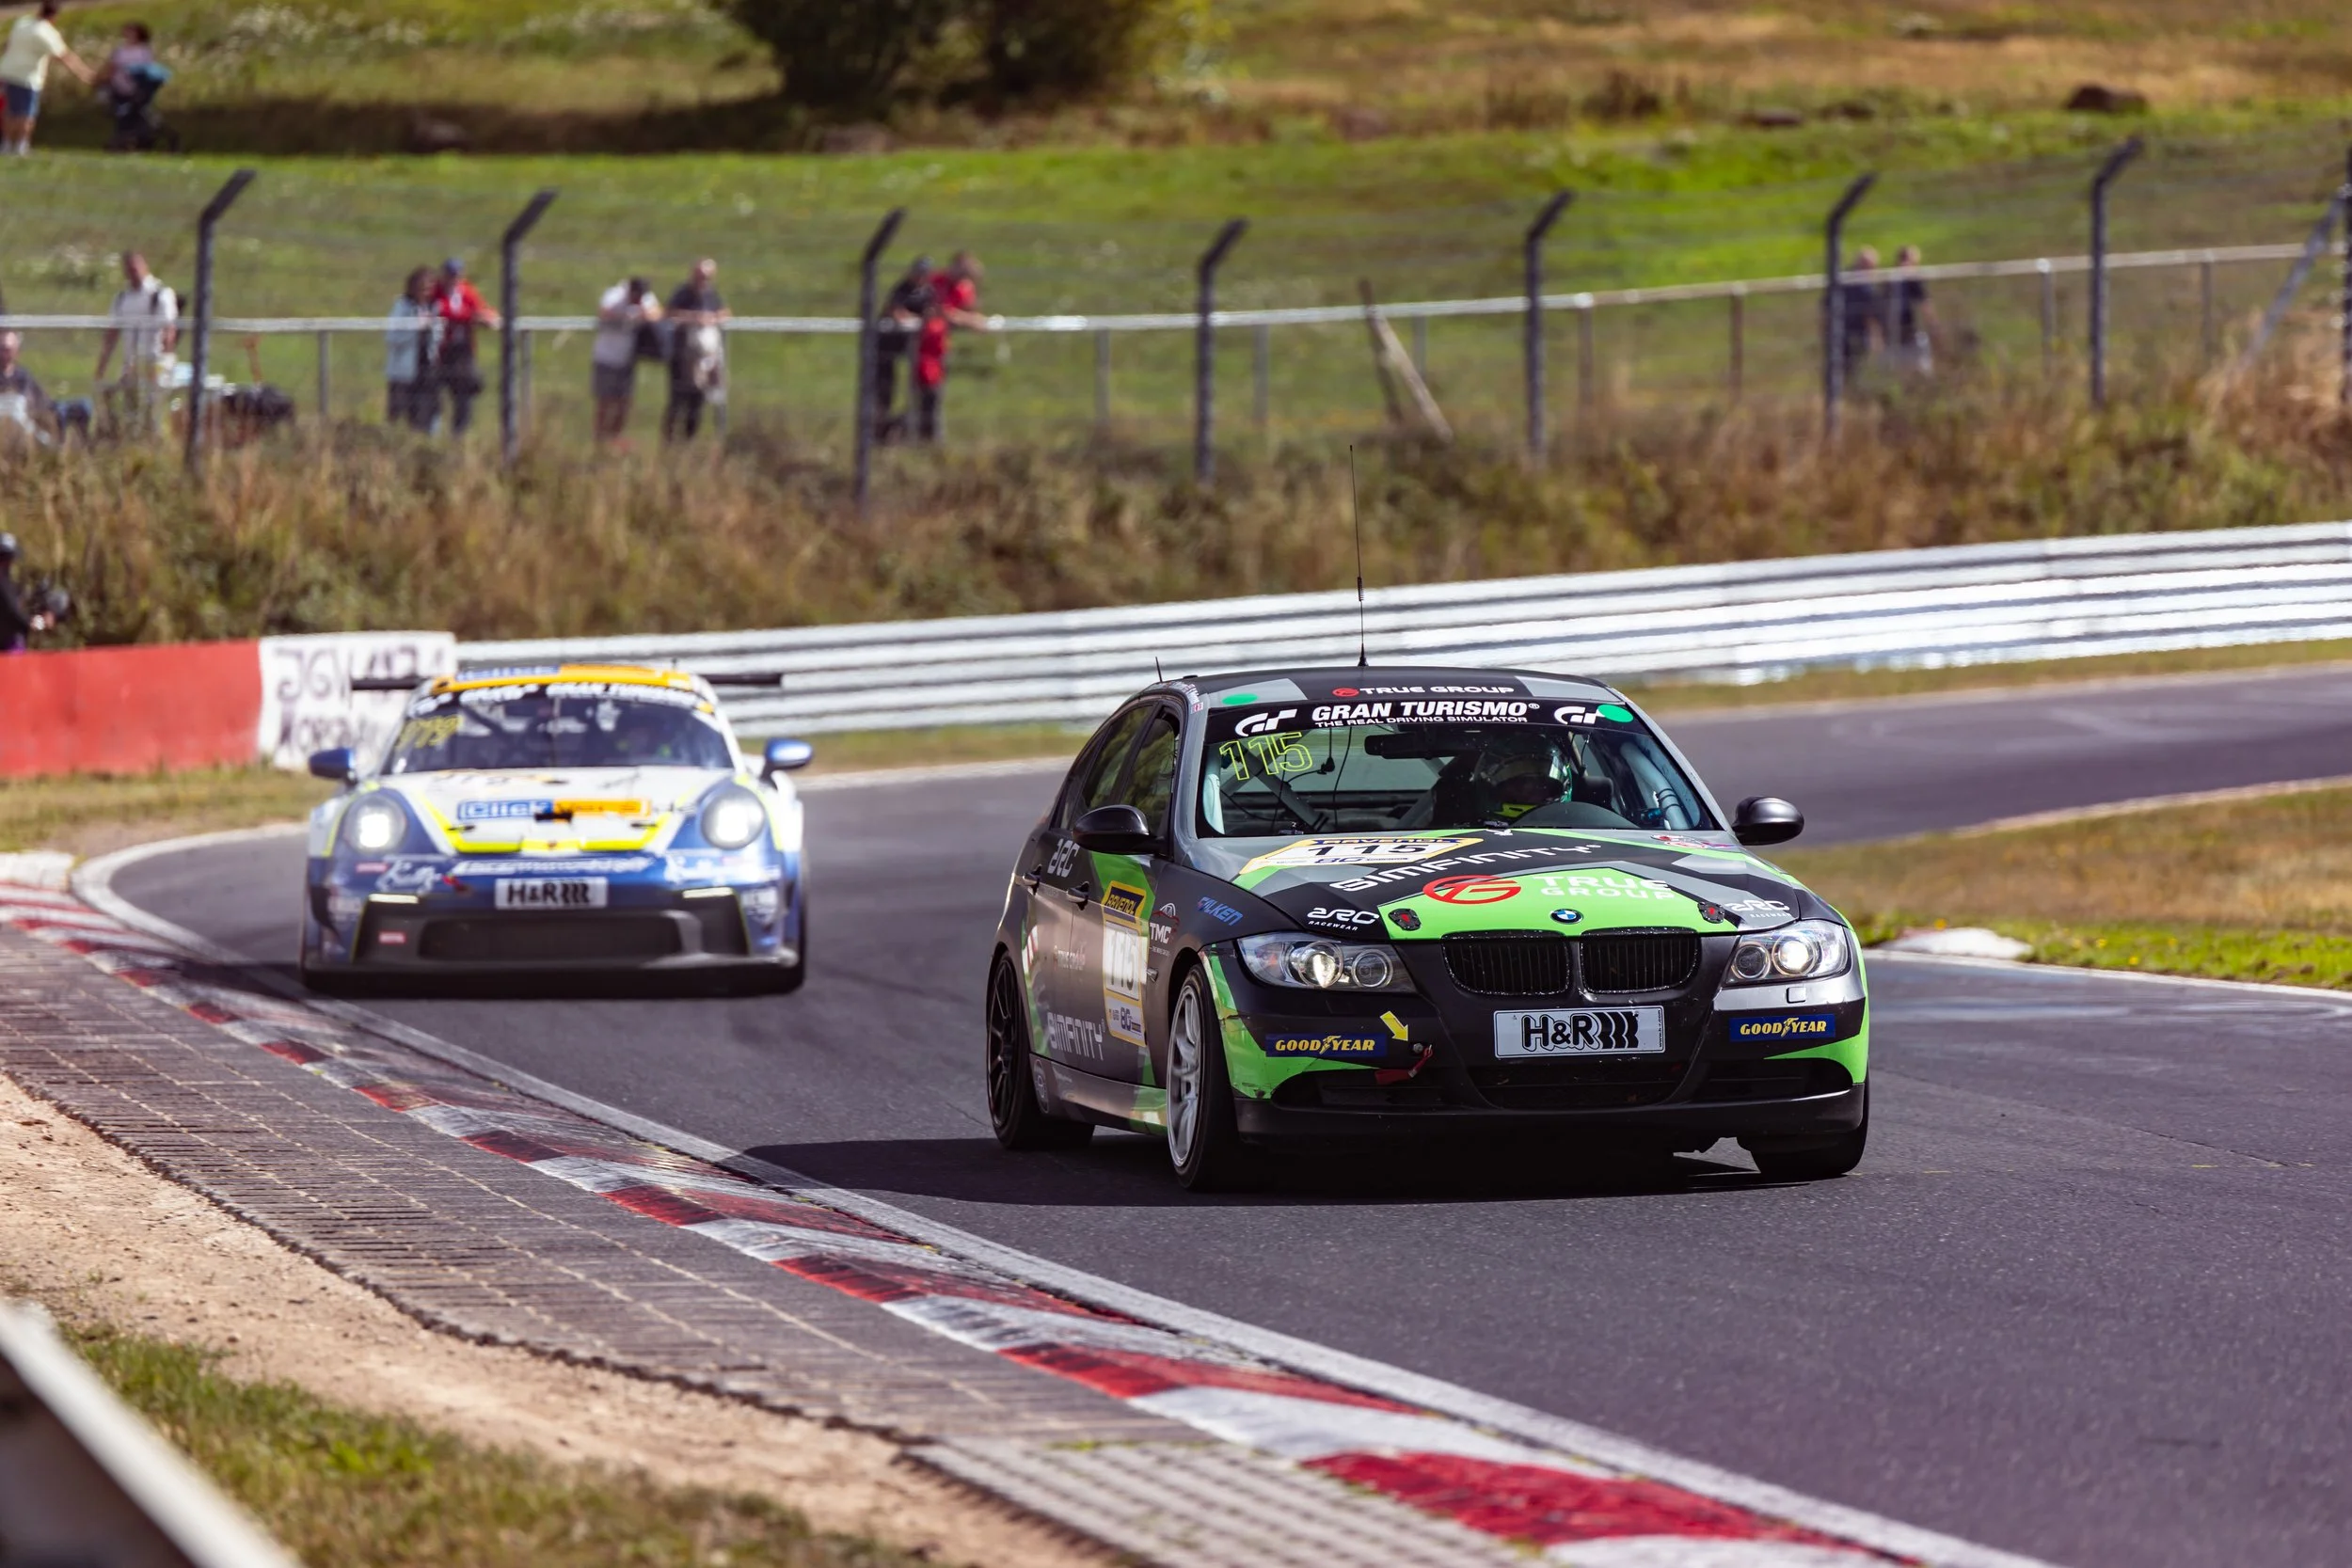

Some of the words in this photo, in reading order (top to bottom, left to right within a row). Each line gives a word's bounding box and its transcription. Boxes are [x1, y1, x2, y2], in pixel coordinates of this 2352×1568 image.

[1359, 686, 1425, 695] TRUE
[1430, 686, 1515, 694] GROUP
[1311, 703, 1392, 721] GRAN
[1346, 718, 1380, 726] REAL
[1219, 732, 1313, 781] 115
[1307, 845, 1429, 856] 115
[1532, 875, 1671, 892] TRUE
[506, 882, 558, 904] H&R
[1540, 887, 1676, 899] GROUP
[1149, 922, 1172, 943] TMC
[1308, 921, 1359, 931] RACEWEAR
[1522, 1013, 1599, 1051] H&R
